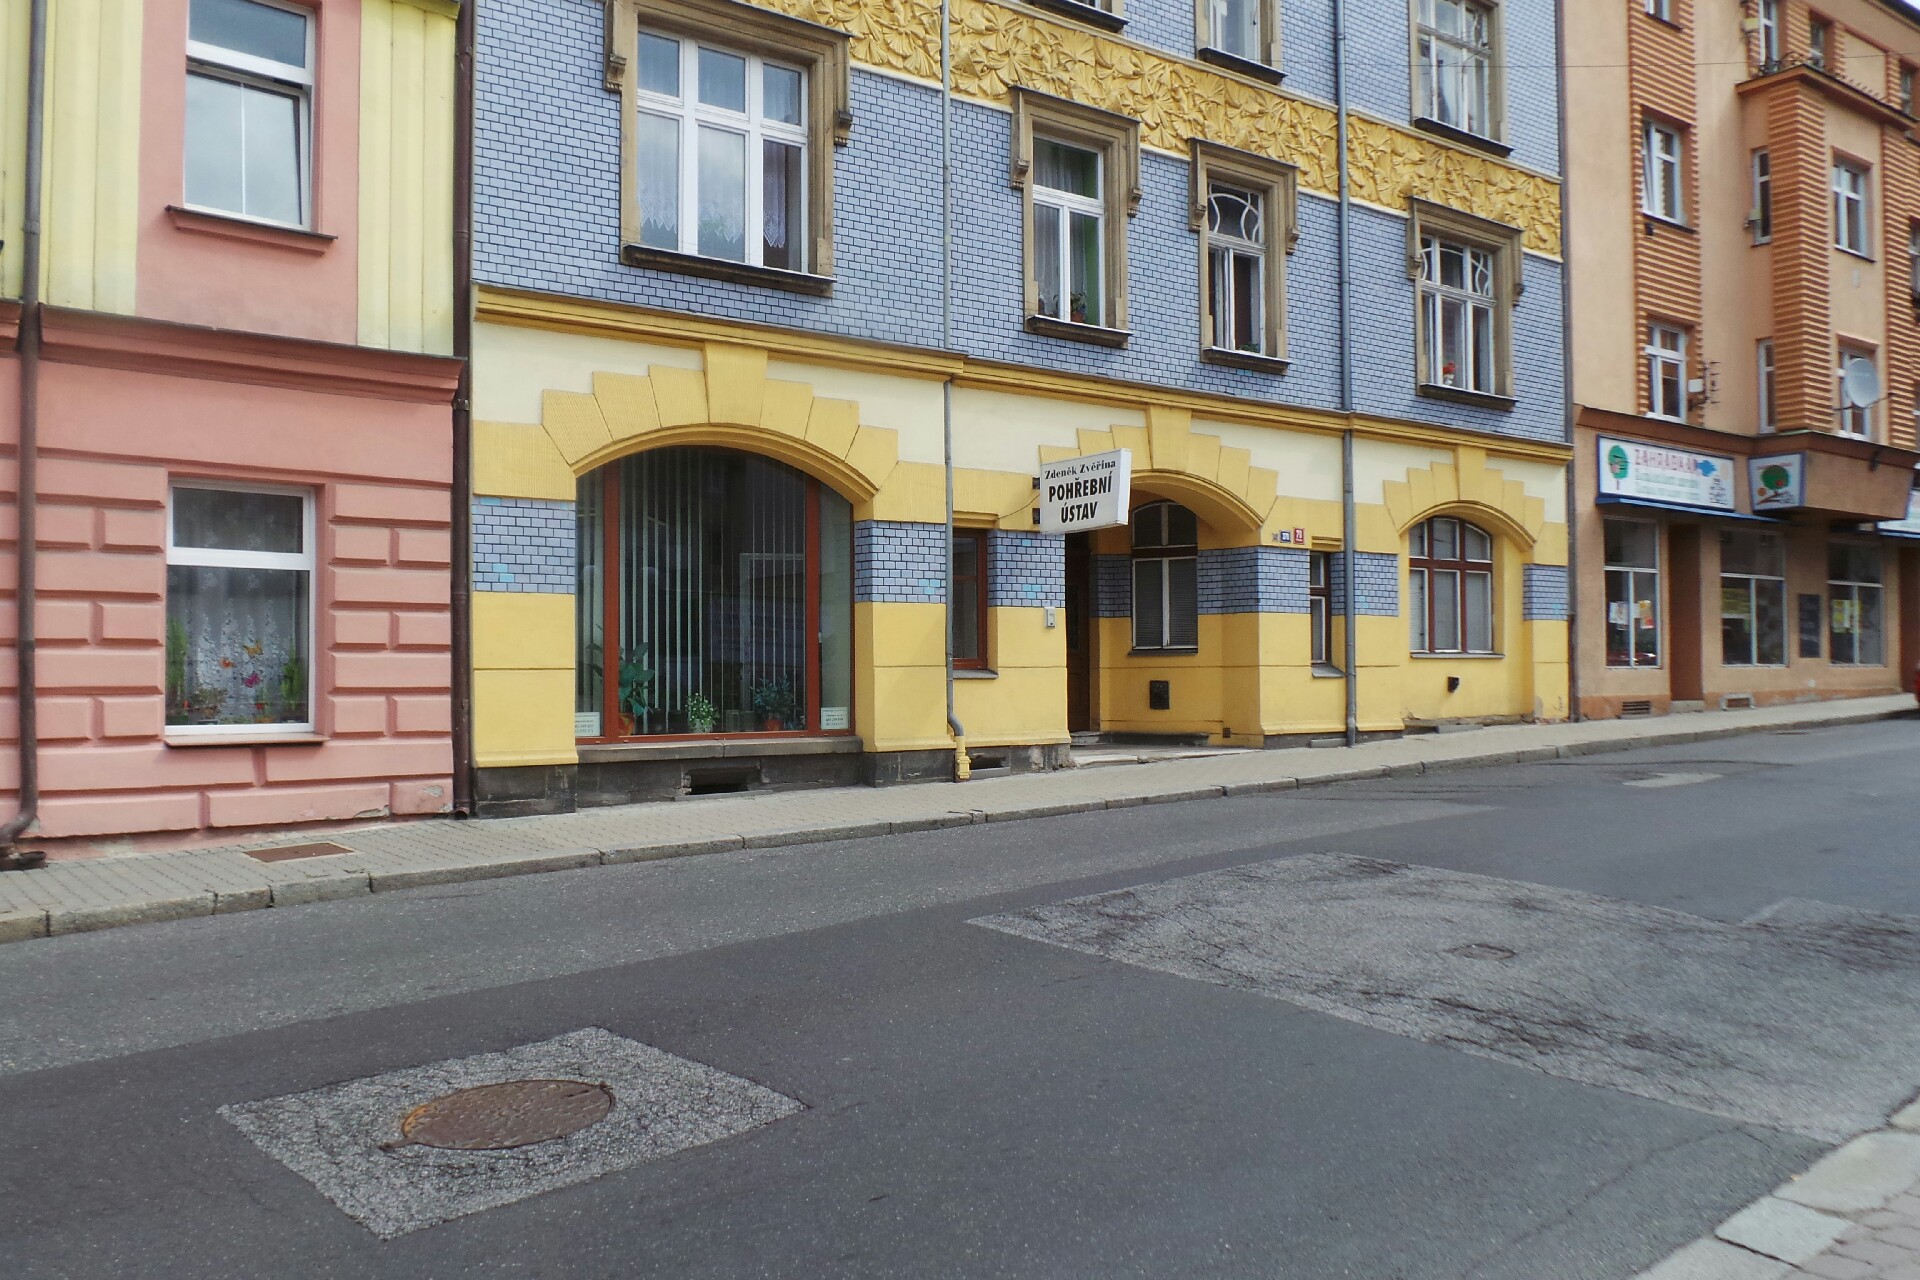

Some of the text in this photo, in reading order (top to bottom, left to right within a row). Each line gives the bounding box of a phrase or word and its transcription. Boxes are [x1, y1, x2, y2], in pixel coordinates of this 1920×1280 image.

[1044, 460, 1116, 480] Zdeněk Zvěřina
[1048, 471, 1113, 503] POHŘEBNÍ
[1061, 502, 1098, 524] ÚSTAV
